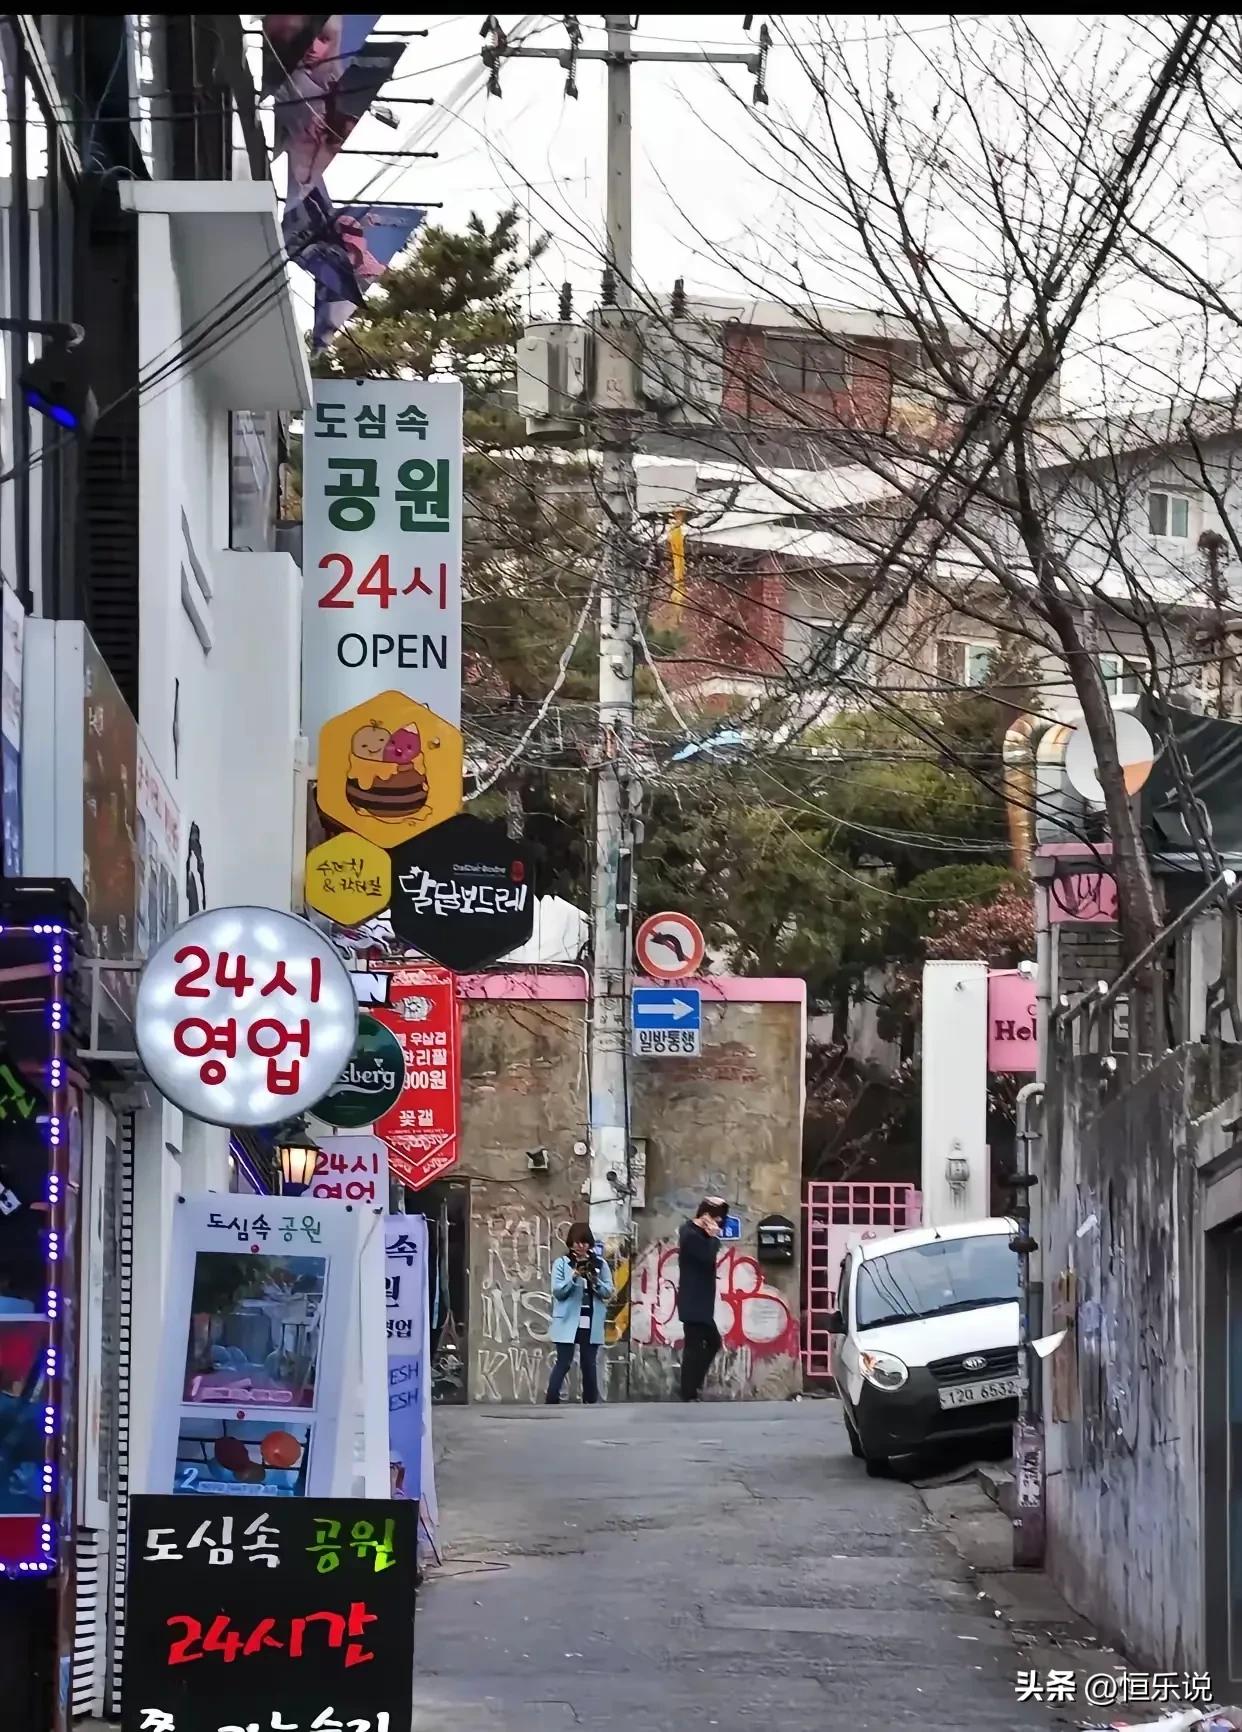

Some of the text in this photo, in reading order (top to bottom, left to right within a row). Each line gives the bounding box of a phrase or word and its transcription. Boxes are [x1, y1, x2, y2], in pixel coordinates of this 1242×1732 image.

[314, 403, 429, 440] 도심속
[324, 457, 450, 533] 공원
[317, 552, 447, 610] 24시
[337, 633, 447, 670] OPEN
[398, 866, 528, 917] 달달보드레
[174, 945, 322, 1003] 24시
[173, 1017, 311, 1096] 영업
[640, 1030, 695, 1053] 일방통행
[314, 1151, 378, 1176] 24시
[207, 1214, 323, 1243] 도심속 공원
[143, 1512, 396, 1573] 도심속 공원
[166, 1602, 378, 1668] 24시간
